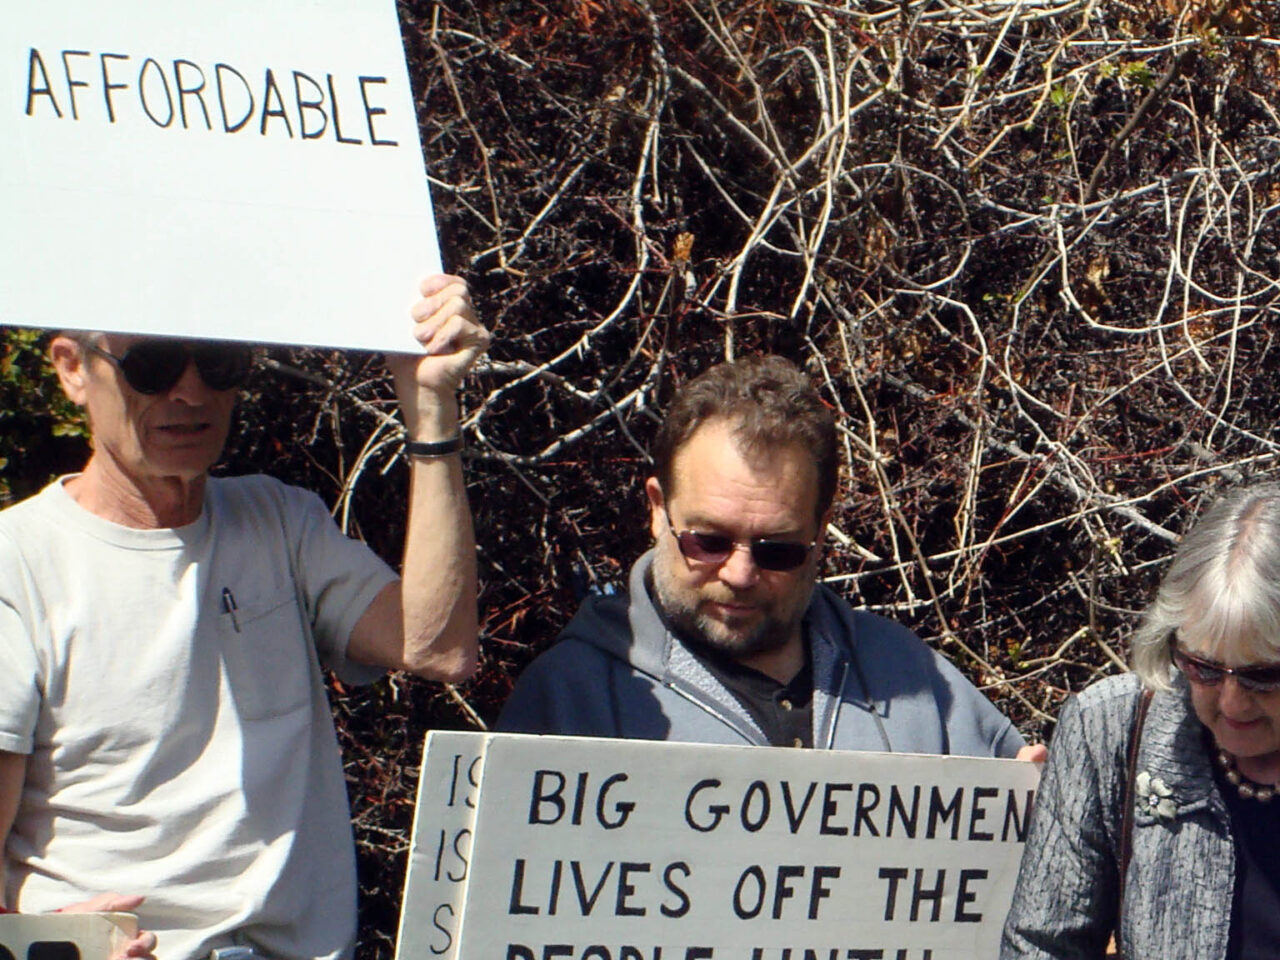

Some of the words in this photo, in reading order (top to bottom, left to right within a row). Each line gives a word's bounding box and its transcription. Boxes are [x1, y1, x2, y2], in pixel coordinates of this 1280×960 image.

[25, 47, 399, 146] AFFORDABLE
[528, 770, 636, 829] BIG
[685, 779, 1034, 842] GOVERNMEN
[434, 828, 471, 882] IS
[508, 859, 691, 919] LIVES
[733, 865, 841, 921] OFF
[878, 868, 988, 923] THE
